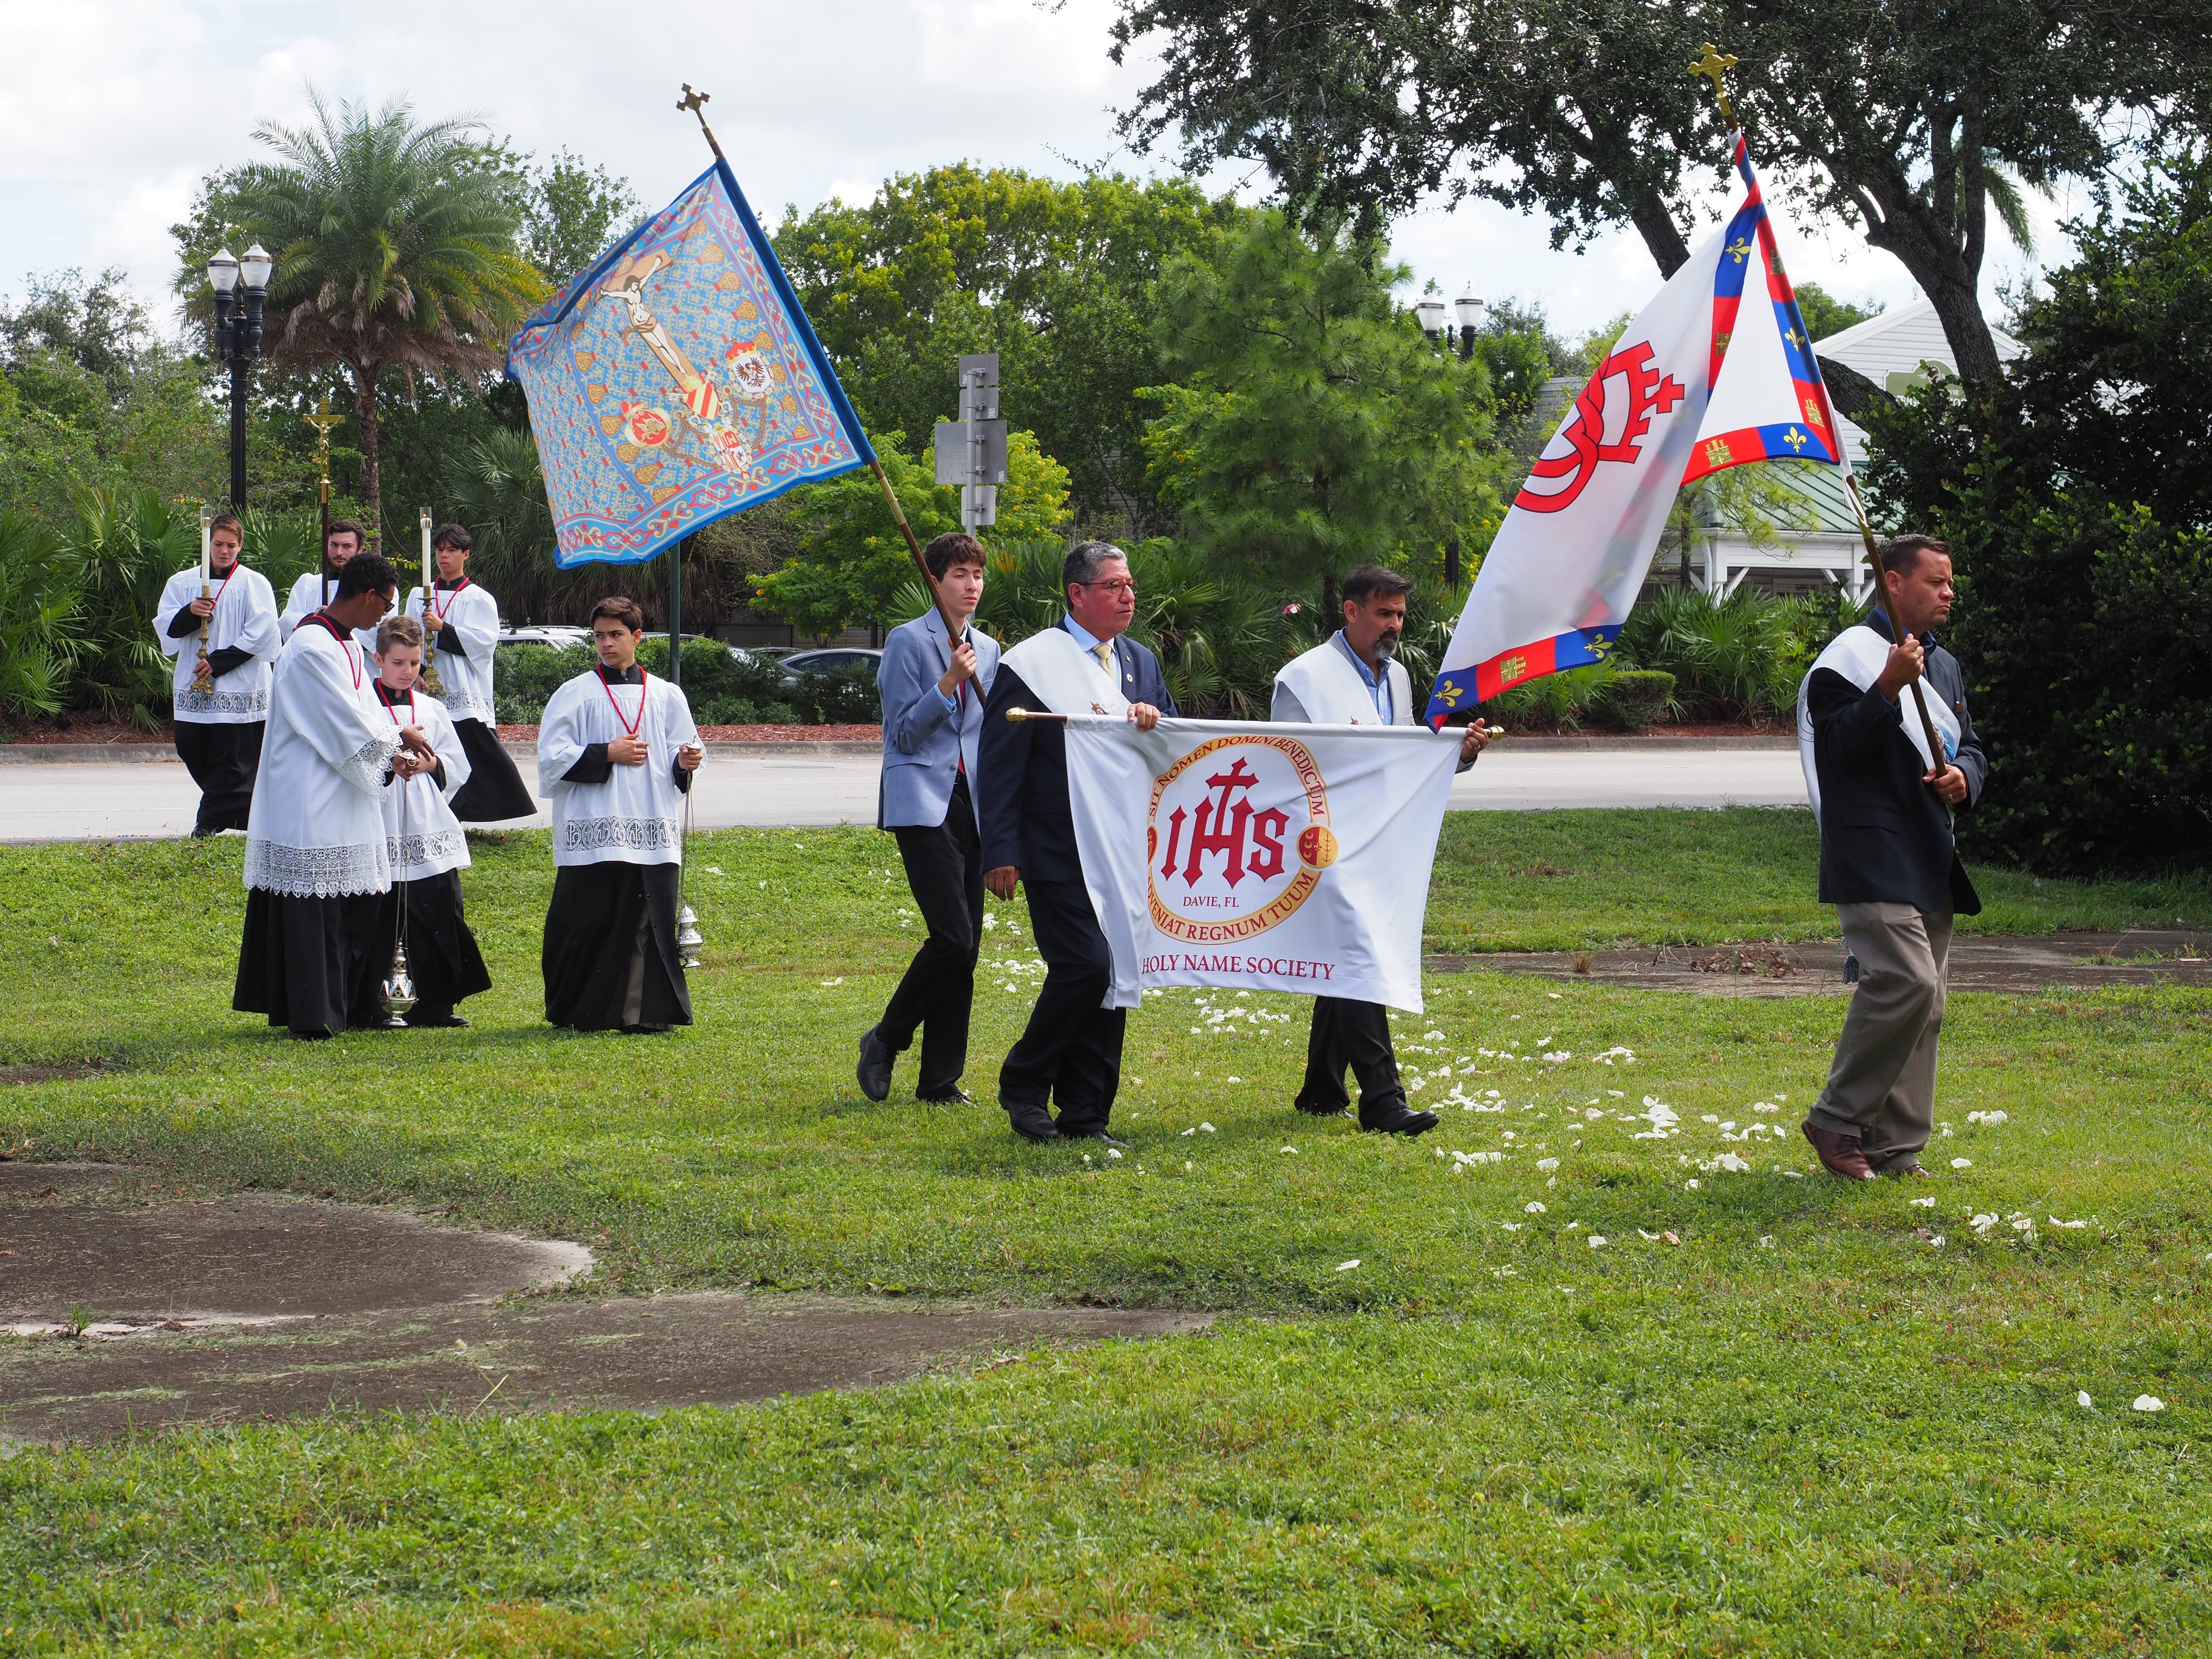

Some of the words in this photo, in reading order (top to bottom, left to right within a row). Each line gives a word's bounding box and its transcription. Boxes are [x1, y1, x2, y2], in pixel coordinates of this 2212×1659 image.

[1149, 788, 1160, 817] SIT
[1157, 742, 1213, 788] NOMEN
[1216, 736, 1278, 749] DOMINI
[1273, 738, 1325, 816] BENEDICTUM
[1161, 756, 1289, 890] IHS
[1182, 896, 1221, 908] DAVIE,
[1224, 896, 1240, 908] FL
[1186, 914, 1268, 940] REGNUM
[1266, 871, 1315, 920] TUUM
[1141, 955, 1180, 974] HOLY
[1183, 955, 1242, 972] NAME
[1246, 957, 1336, 980] SOCIETY
